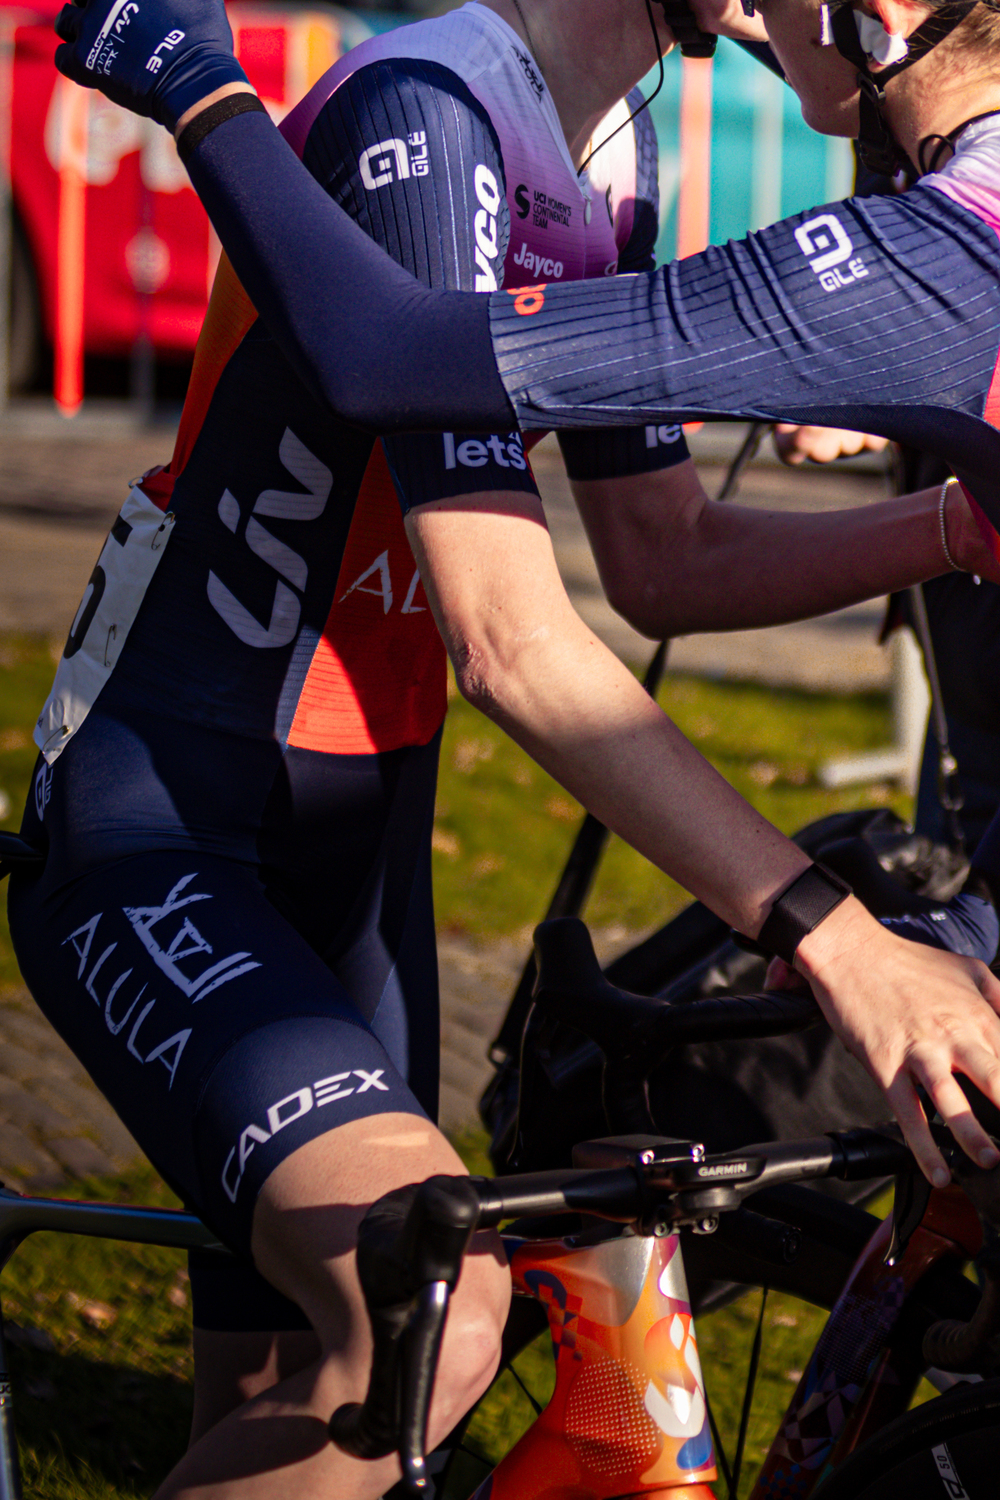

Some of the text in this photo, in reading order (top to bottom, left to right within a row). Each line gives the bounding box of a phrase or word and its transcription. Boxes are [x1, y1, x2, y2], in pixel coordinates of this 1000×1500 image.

[115, 2, 140, 34] Liv
[533, 190, 548, 206] UCI
[532, 204, 570, 227] CONTINENTAL
[532, 216, 549, 230] TEAM
[513, 242, 564, 279] Jayco
[207, 426, 334, 648] Liv
[60, 911, 193, 1092] ALULA
[221, 1069, 390, 1204] CADEX
[697, 1161, 748, 1177] GARMIN
